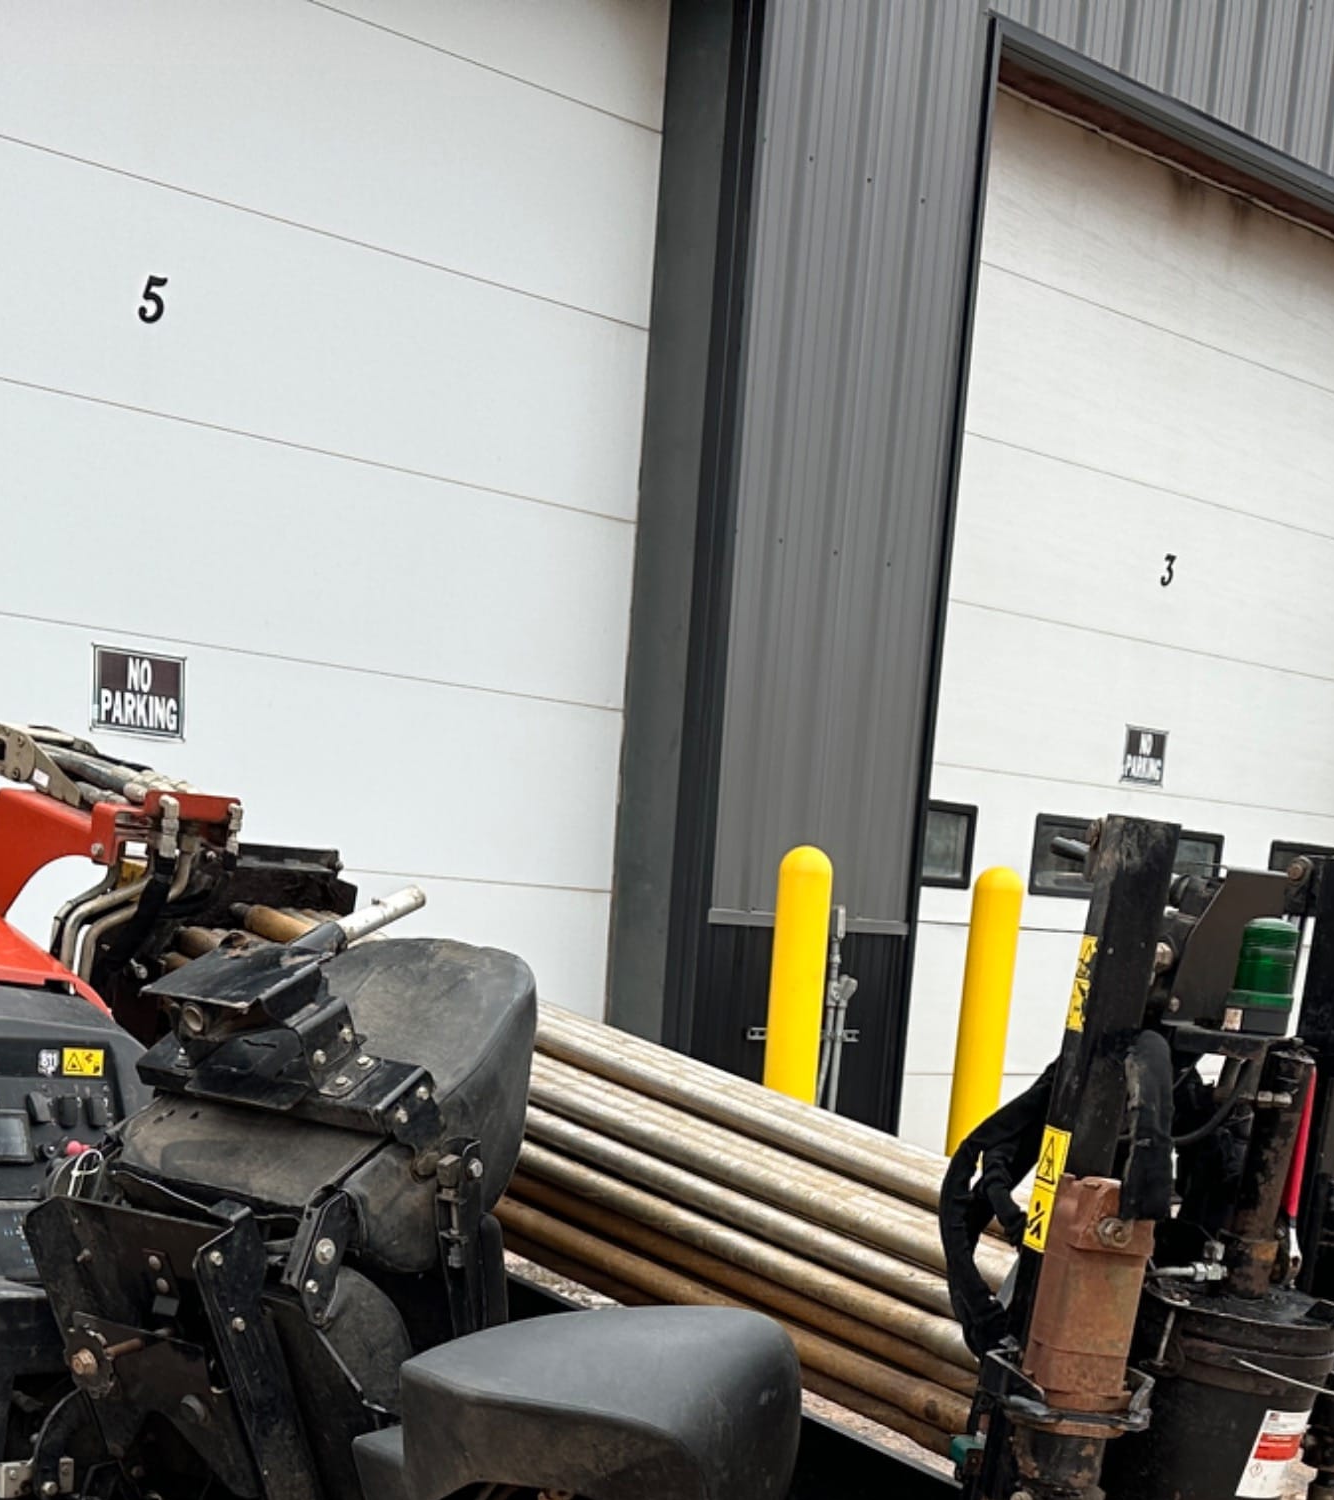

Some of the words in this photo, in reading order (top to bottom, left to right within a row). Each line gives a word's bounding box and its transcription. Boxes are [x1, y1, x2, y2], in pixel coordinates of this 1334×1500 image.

[138, 274, 168, 324] 5
[1160, 553, 1177, 587] 3
[127, 656, 152, 693] NO
[100, 687, 178, 731] PARKING
